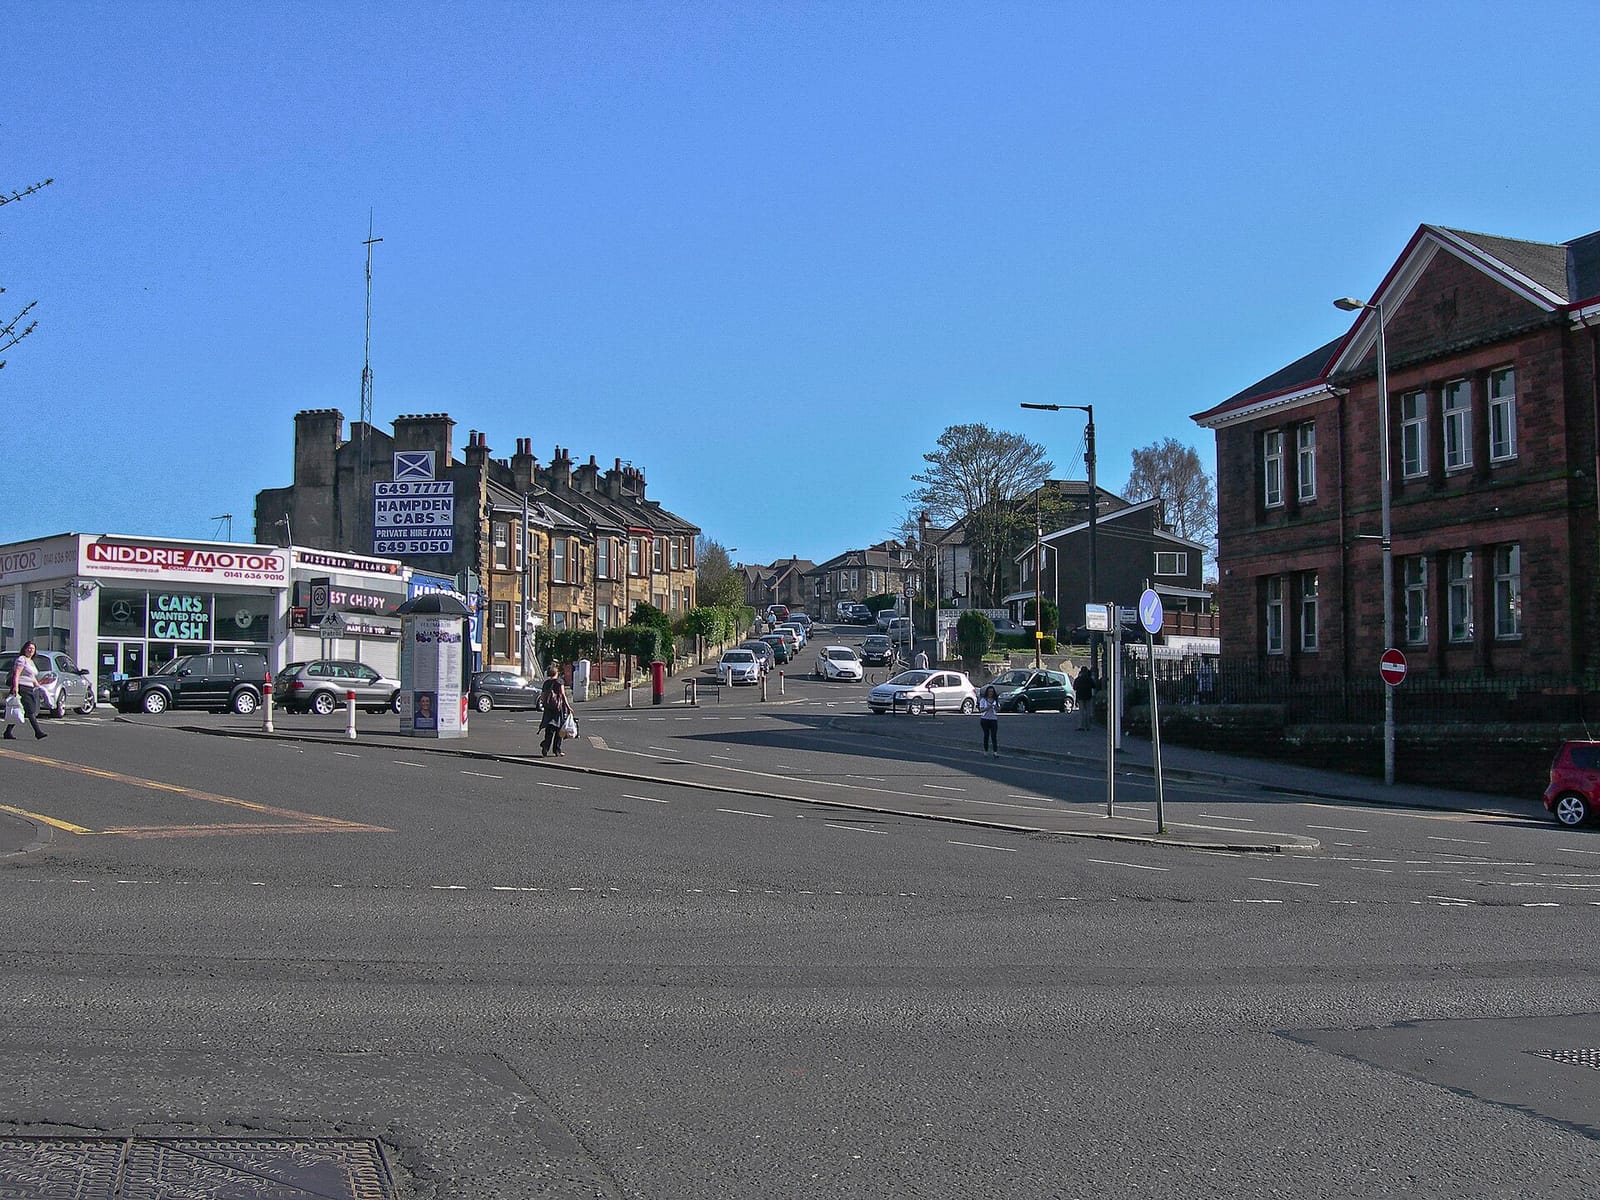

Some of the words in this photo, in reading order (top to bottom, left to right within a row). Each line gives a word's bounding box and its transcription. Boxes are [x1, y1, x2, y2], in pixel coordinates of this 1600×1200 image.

[378, 484, 409, 494] 649
[413, 482, 450, 493] 7777
[377, 500, 451, 511] HAMPDEN
[393, 512, 435, 524] CABS
[376, 530, 408, 538] PRIVATE
[410, 529, 428, 537] HIRE
[377, 542, 406, 552] 649
[410, 541, 450, 552] 5050
[94, 545, 185, 565] NIDDRIE
[195, 553, 278, 570] MOTOR
[305, 554, 347, 567] PIZZERIA
[354, 563, 386, 572] MILANO
[158, 595, 203, 612] CARS
[150, 611, 189, 621] WANTED
[191, 613, 209, 622] FOR
[154, 620, 203, 639] CASH
